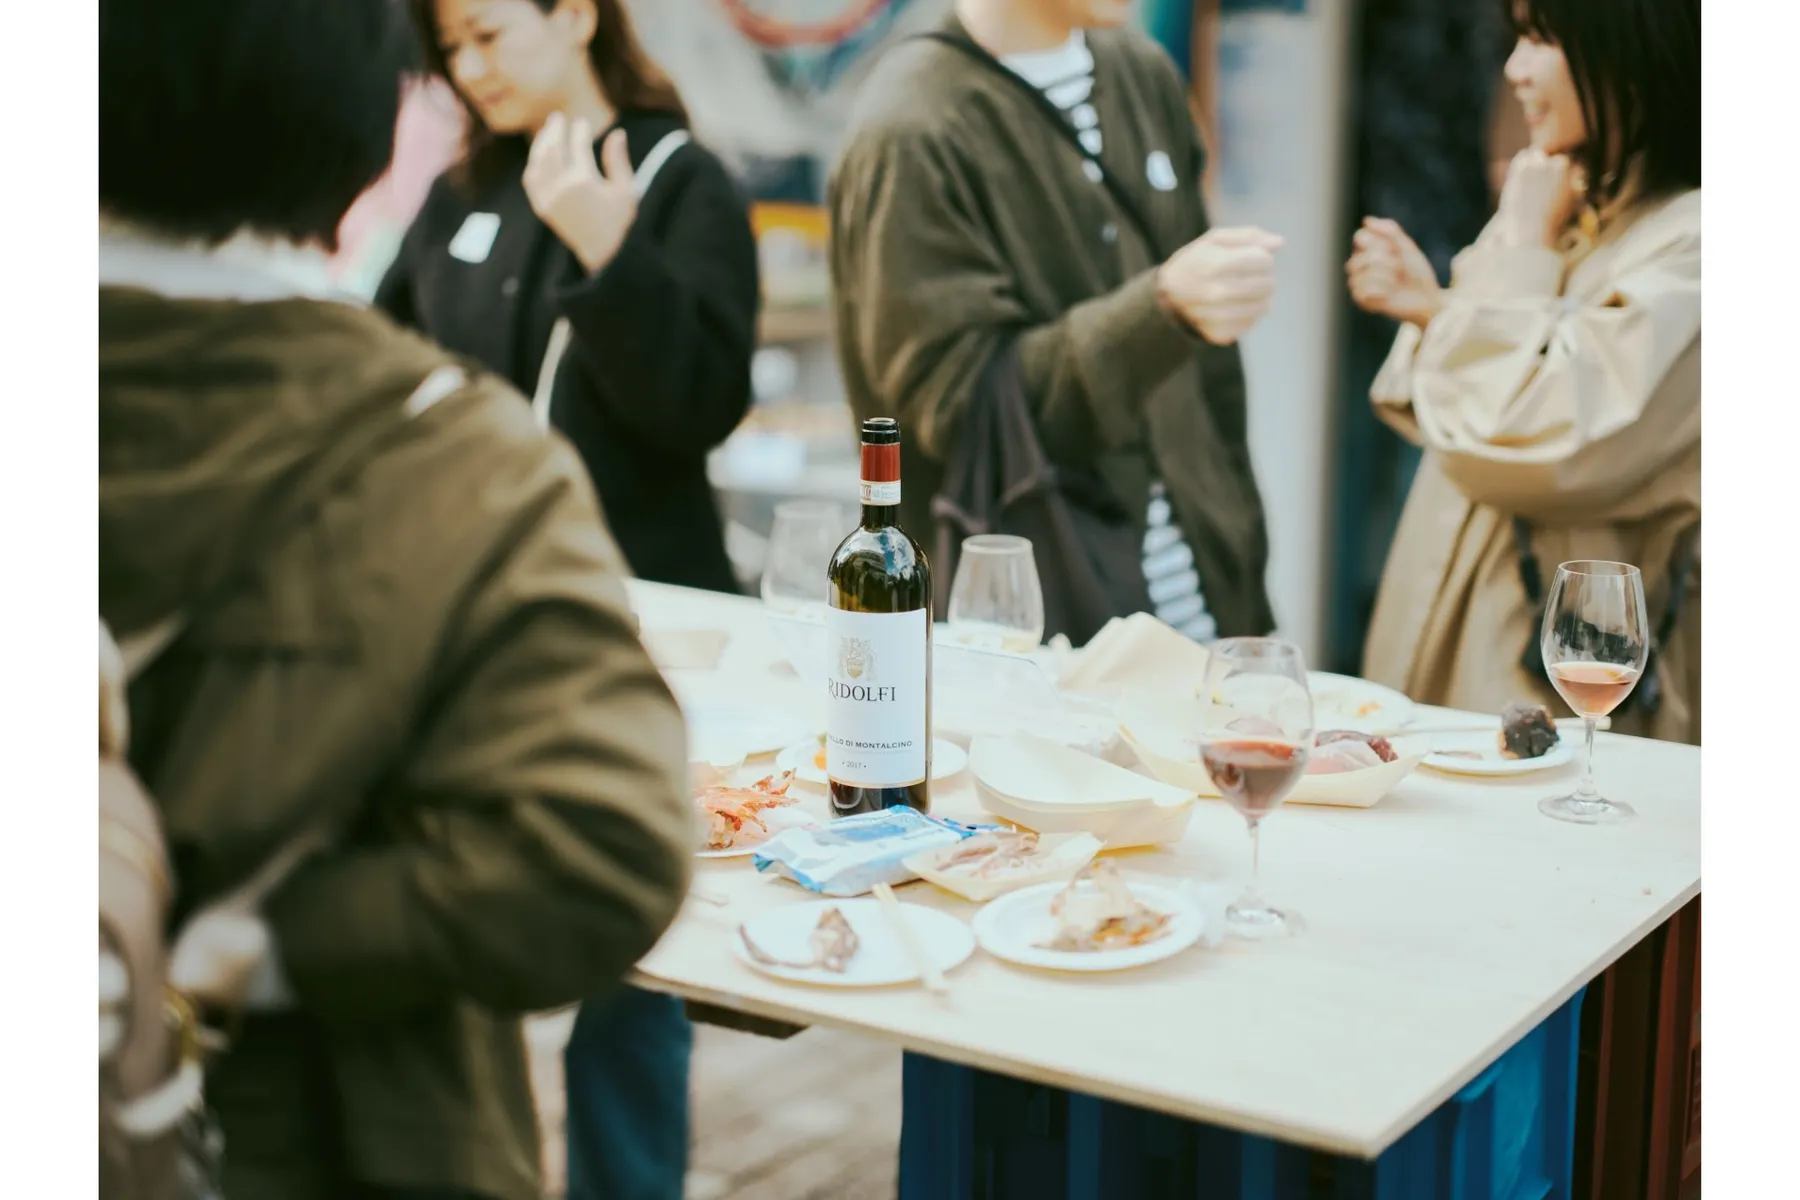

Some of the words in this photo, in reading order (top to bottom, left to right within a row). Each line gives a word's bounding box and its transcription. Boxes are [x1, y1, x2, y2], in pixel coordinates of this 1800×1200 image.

[828, 678, 896, 702] RIDOLFI
[855, 741, 912, 749] MONTALCINO
[846, 761, 862, 769] 2017
